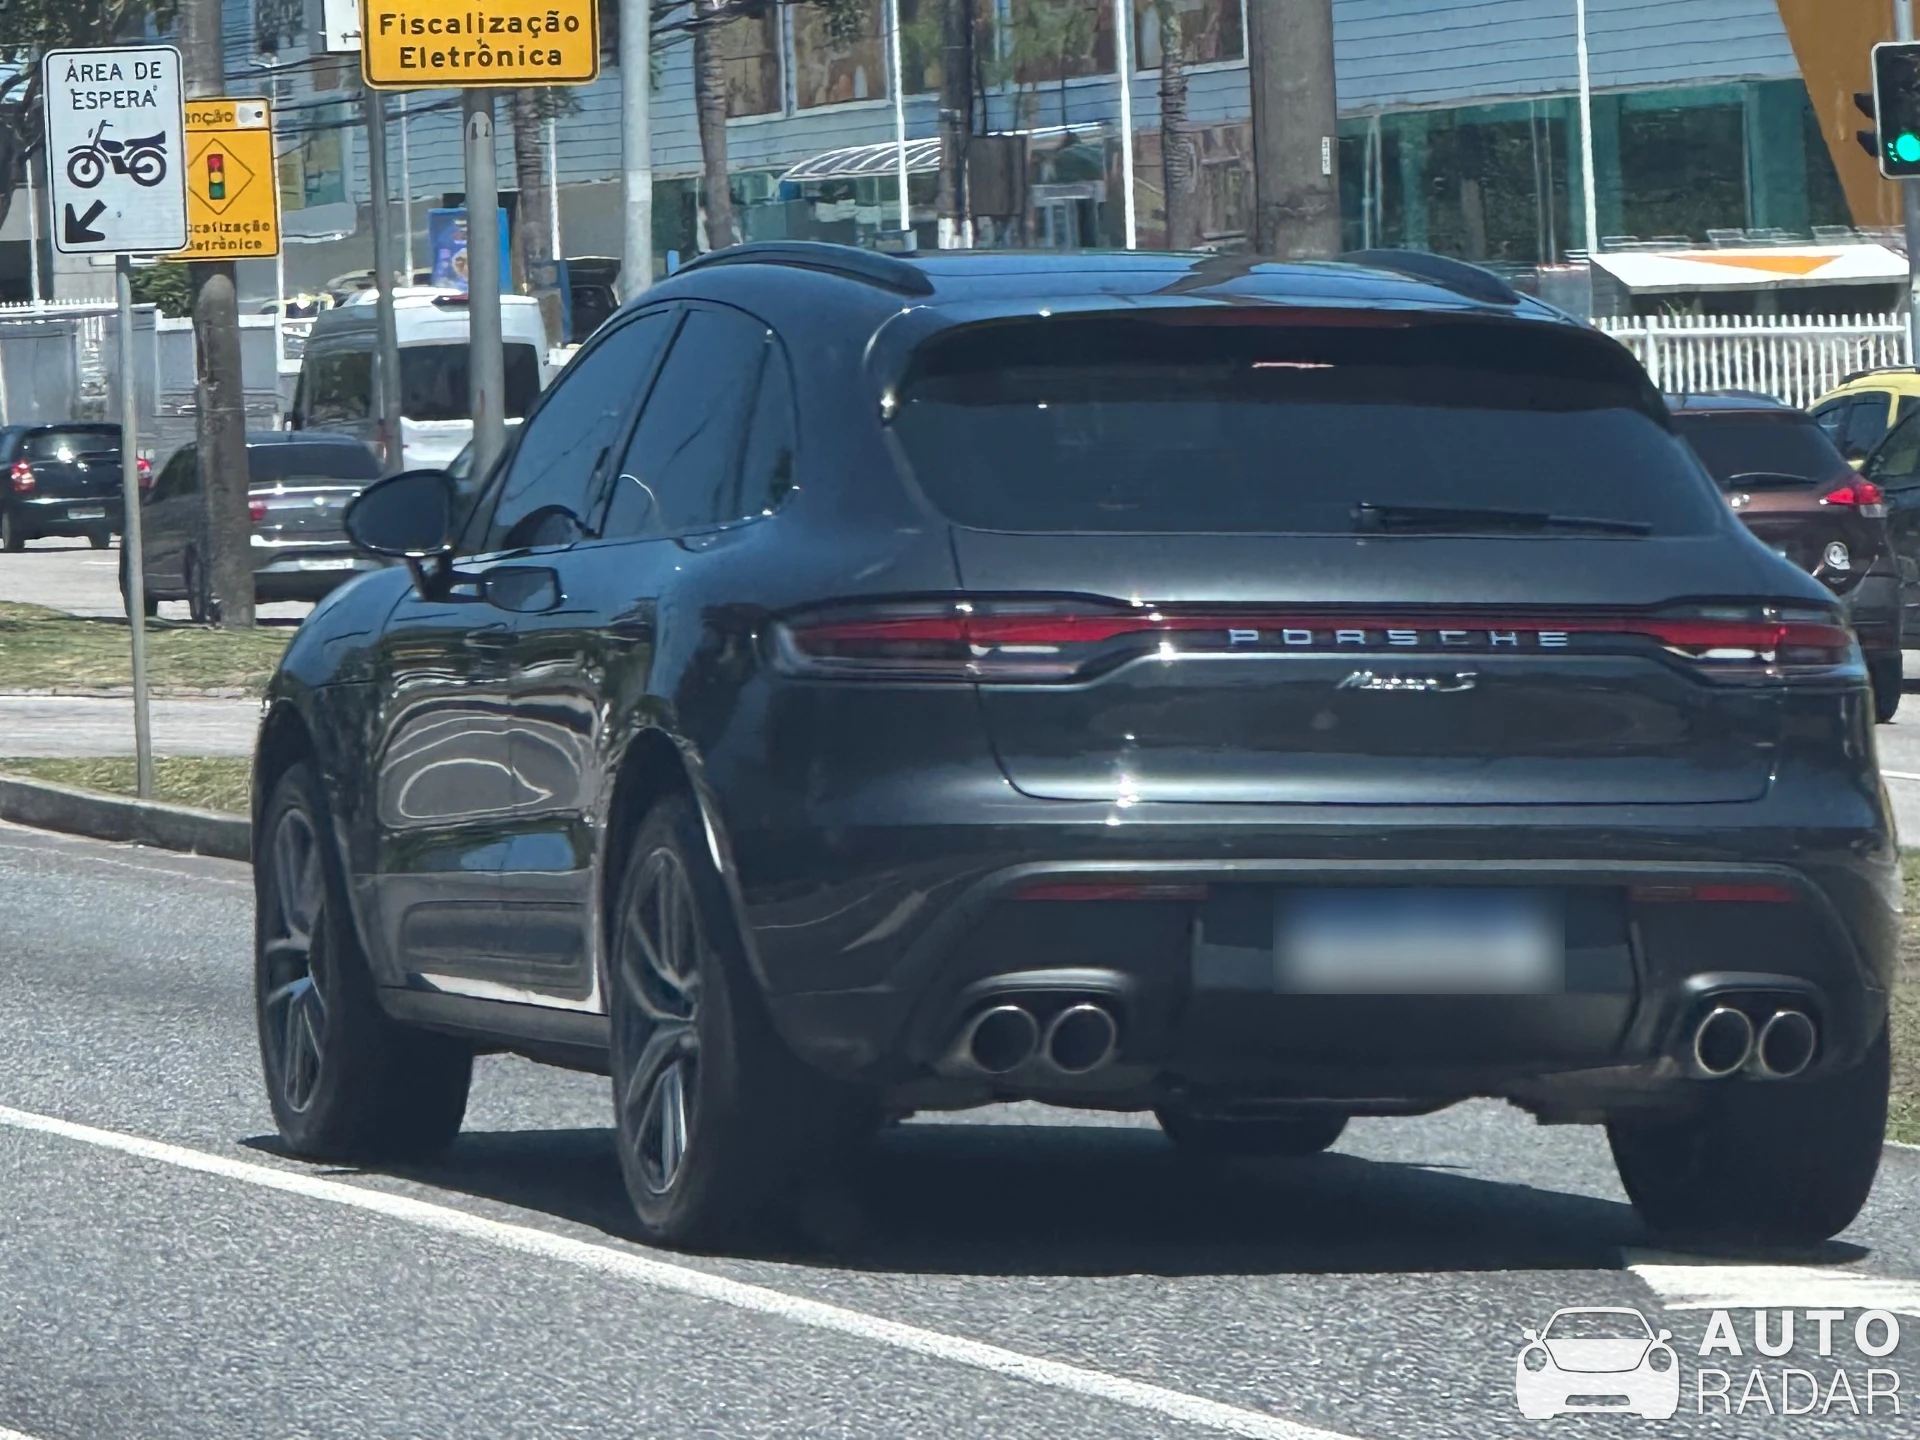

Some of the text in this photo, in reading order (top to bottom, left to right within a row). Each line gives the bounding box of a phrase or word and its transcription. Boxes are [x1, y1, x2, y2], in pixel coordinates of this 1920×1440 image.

[379, 11, 580, 39] Fiscalização
[399, 44, 563, 69] Eletrônica
[64, 58, 163, 83] ÁREA DE
[71, 89, 158, 111] ESPERA
[1228, 628, 1569, 647] PORSCHE
